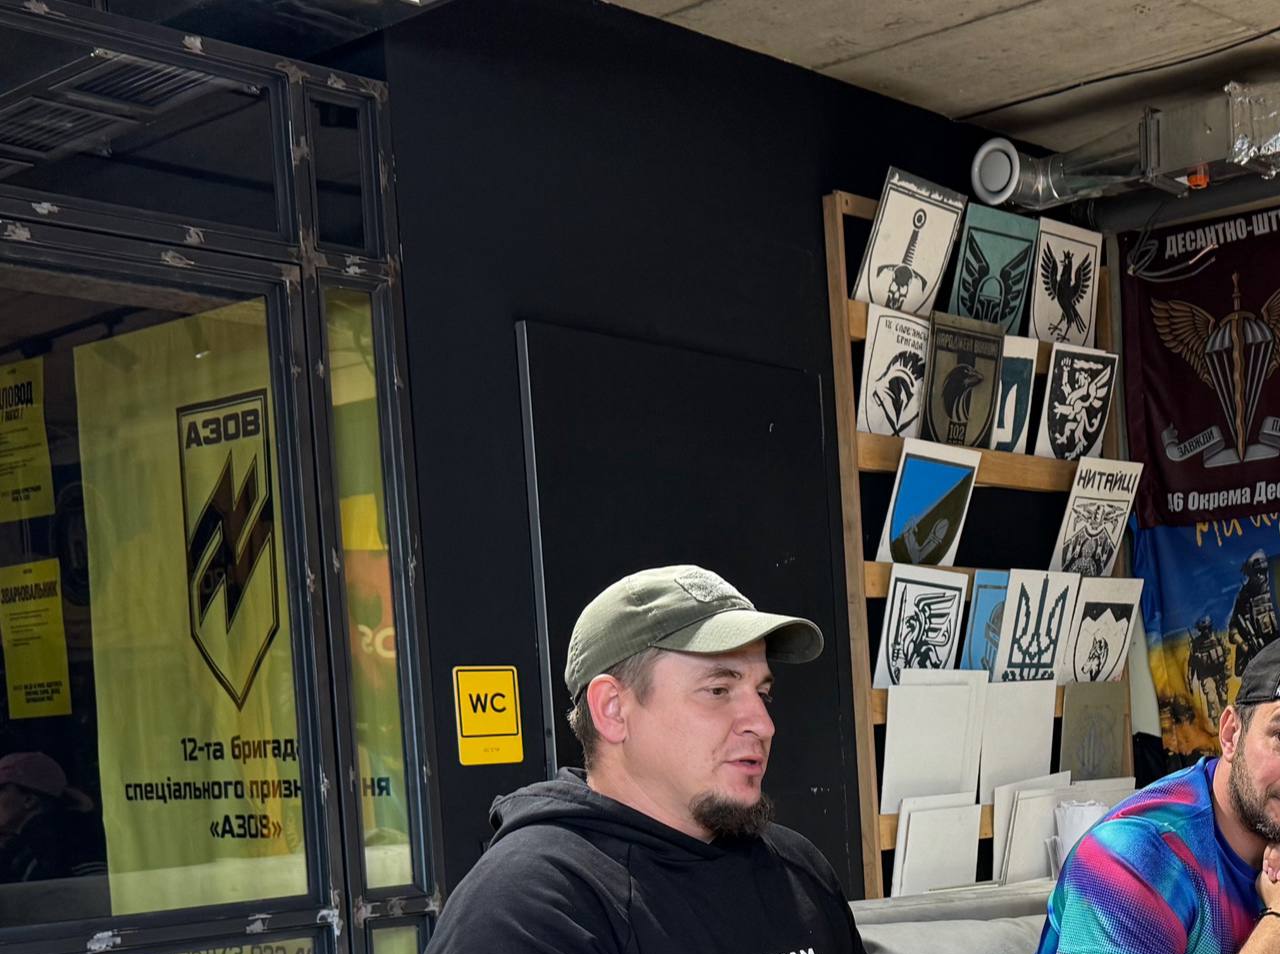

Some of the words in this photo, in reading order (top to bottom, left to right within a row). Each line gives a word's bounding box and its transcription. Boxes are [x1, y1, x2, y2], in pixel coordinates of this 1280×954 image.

[185, 408, 261, 449] АЗОВ
[949, 423, 965, 440] 102
[1177, 429, 1216, 458] ЗАВЖДИ
[1187, 486, 1252, 511] Окрема
[468, 692, 507, 714] WC
[181, 736, 225, 762] 12-та
[230, 735, 301, 765] бригад
[125, 776, 245, 804] спеціального
[209, 814, 283, 839] «АЗОВ»
